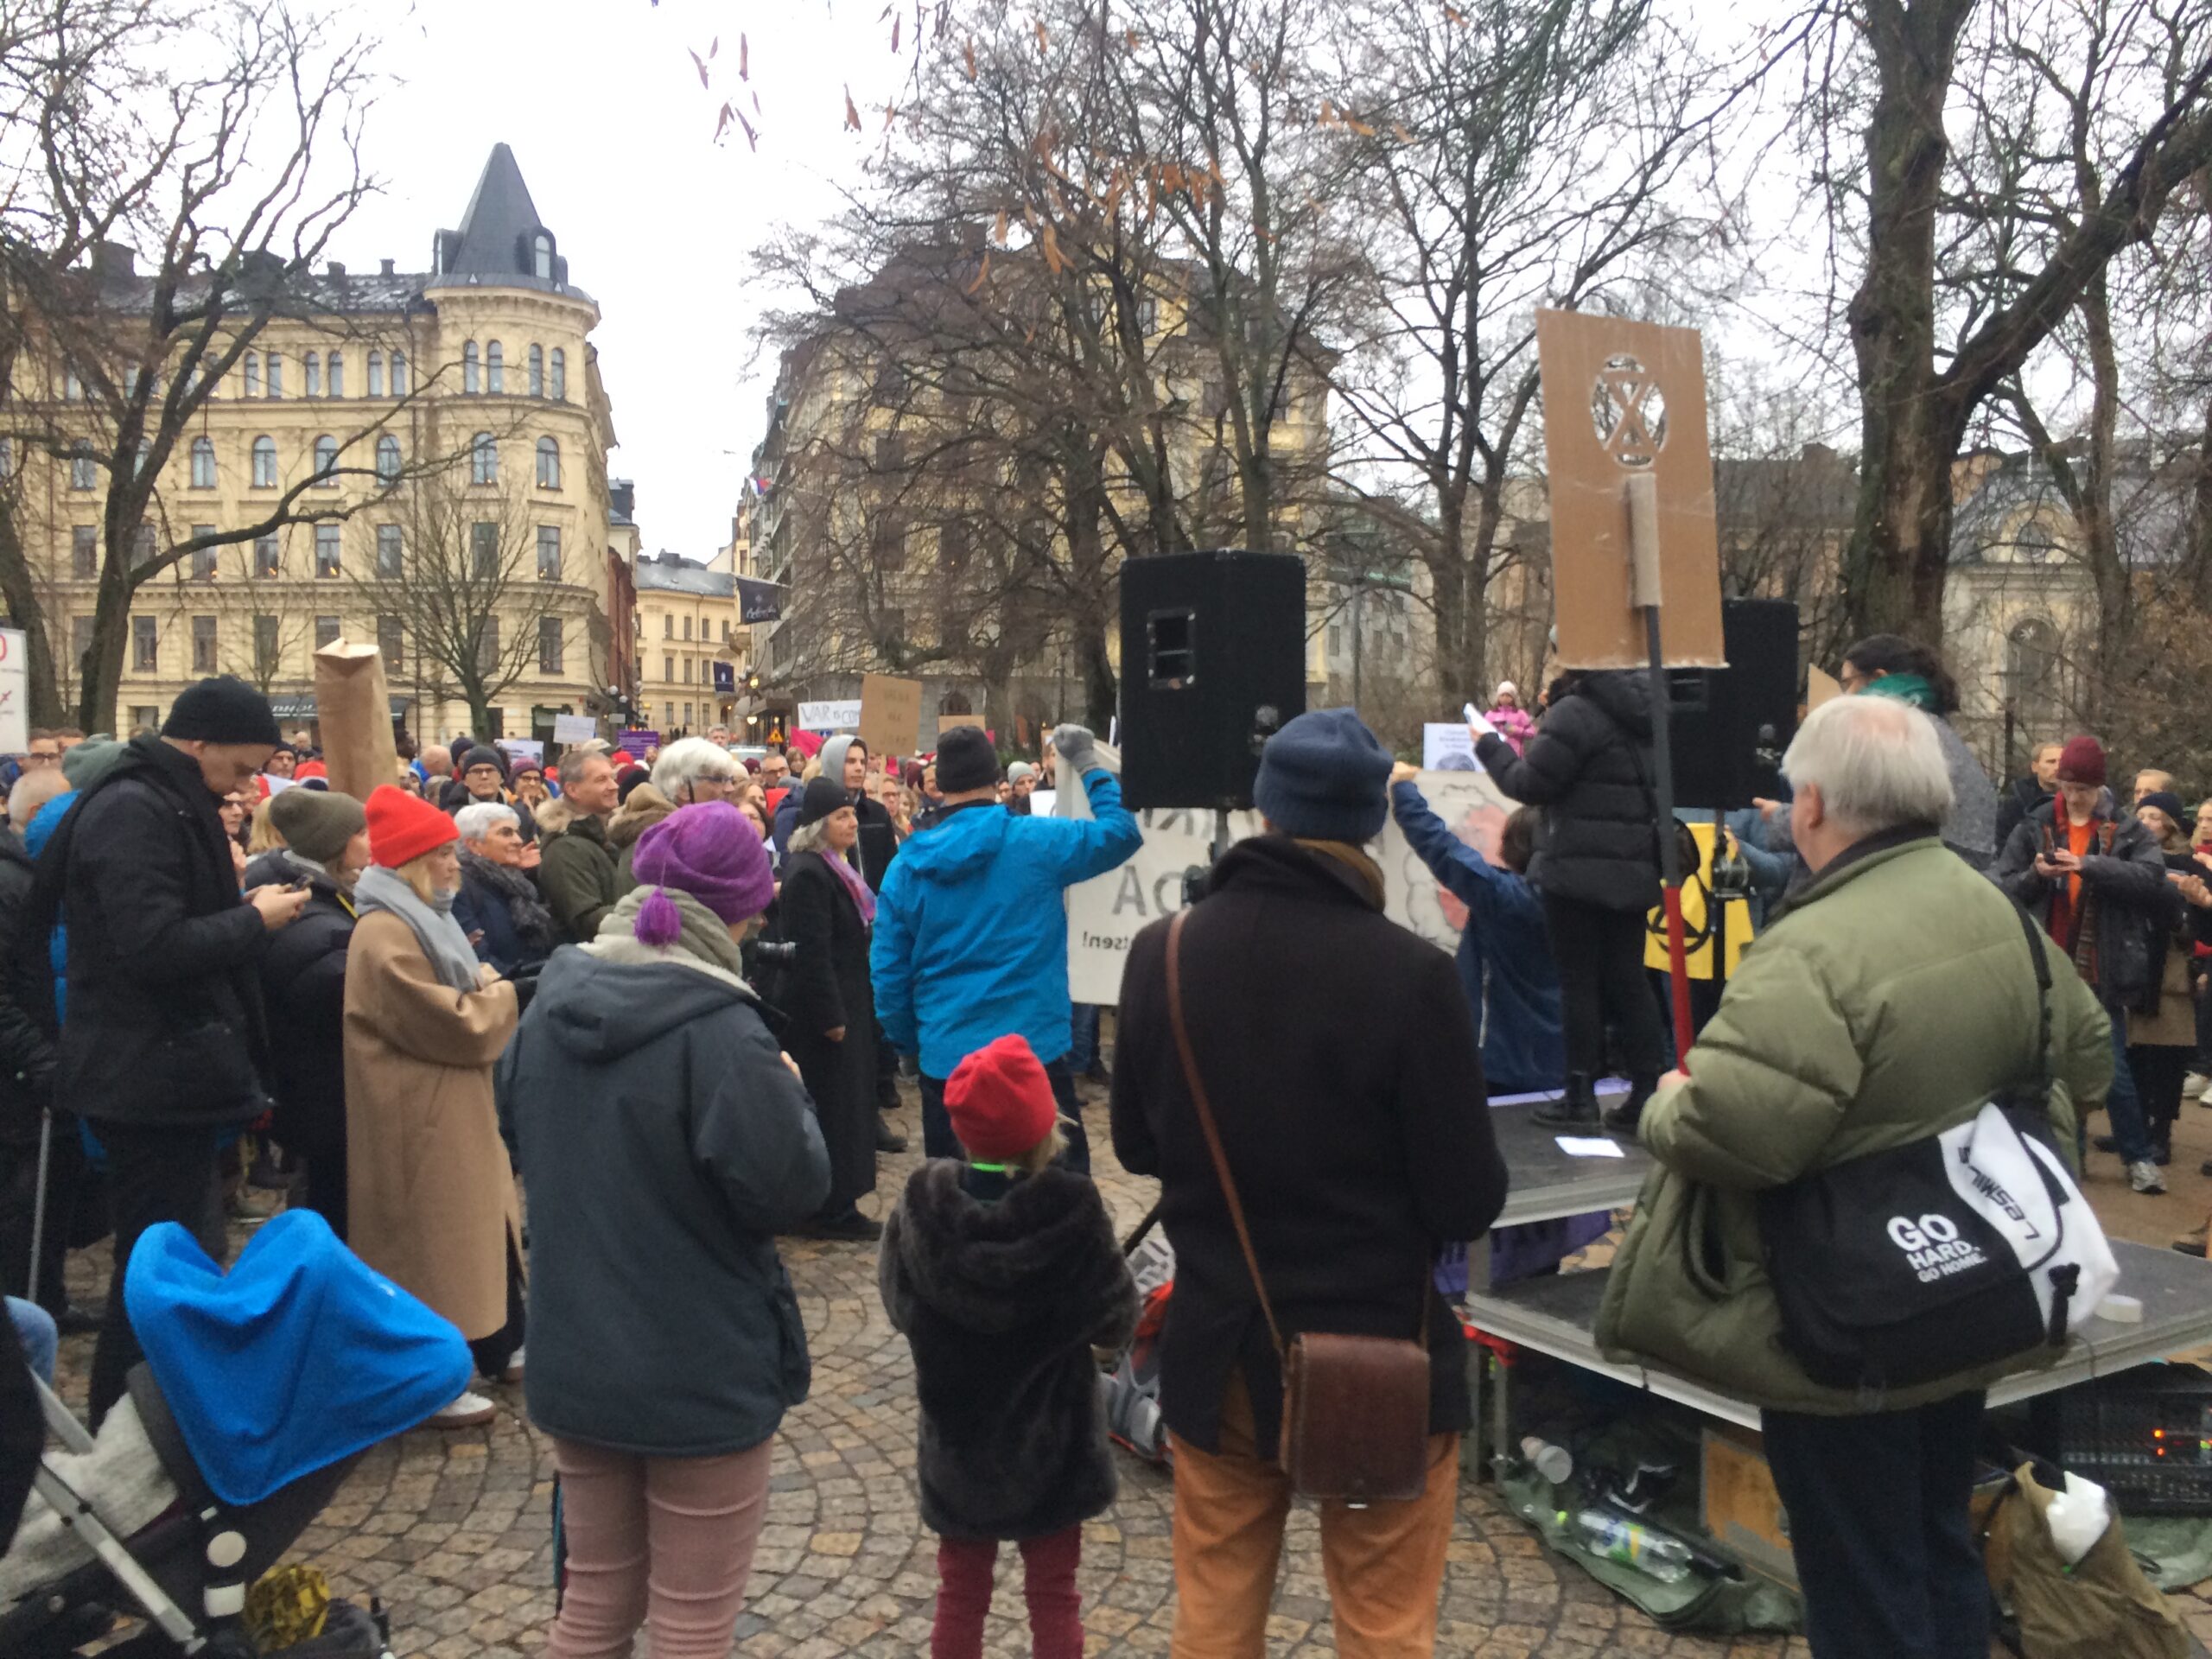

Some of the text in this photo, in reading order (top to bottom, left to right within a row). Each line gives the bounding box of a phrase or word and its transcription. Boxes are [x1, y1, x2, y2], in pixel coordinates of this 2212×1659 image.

[1886, 1213, 1958, 1252] GO
[1906, 1240, 1980, 1270] HARD.
[1917, 1267, 1940, 1283] GO
